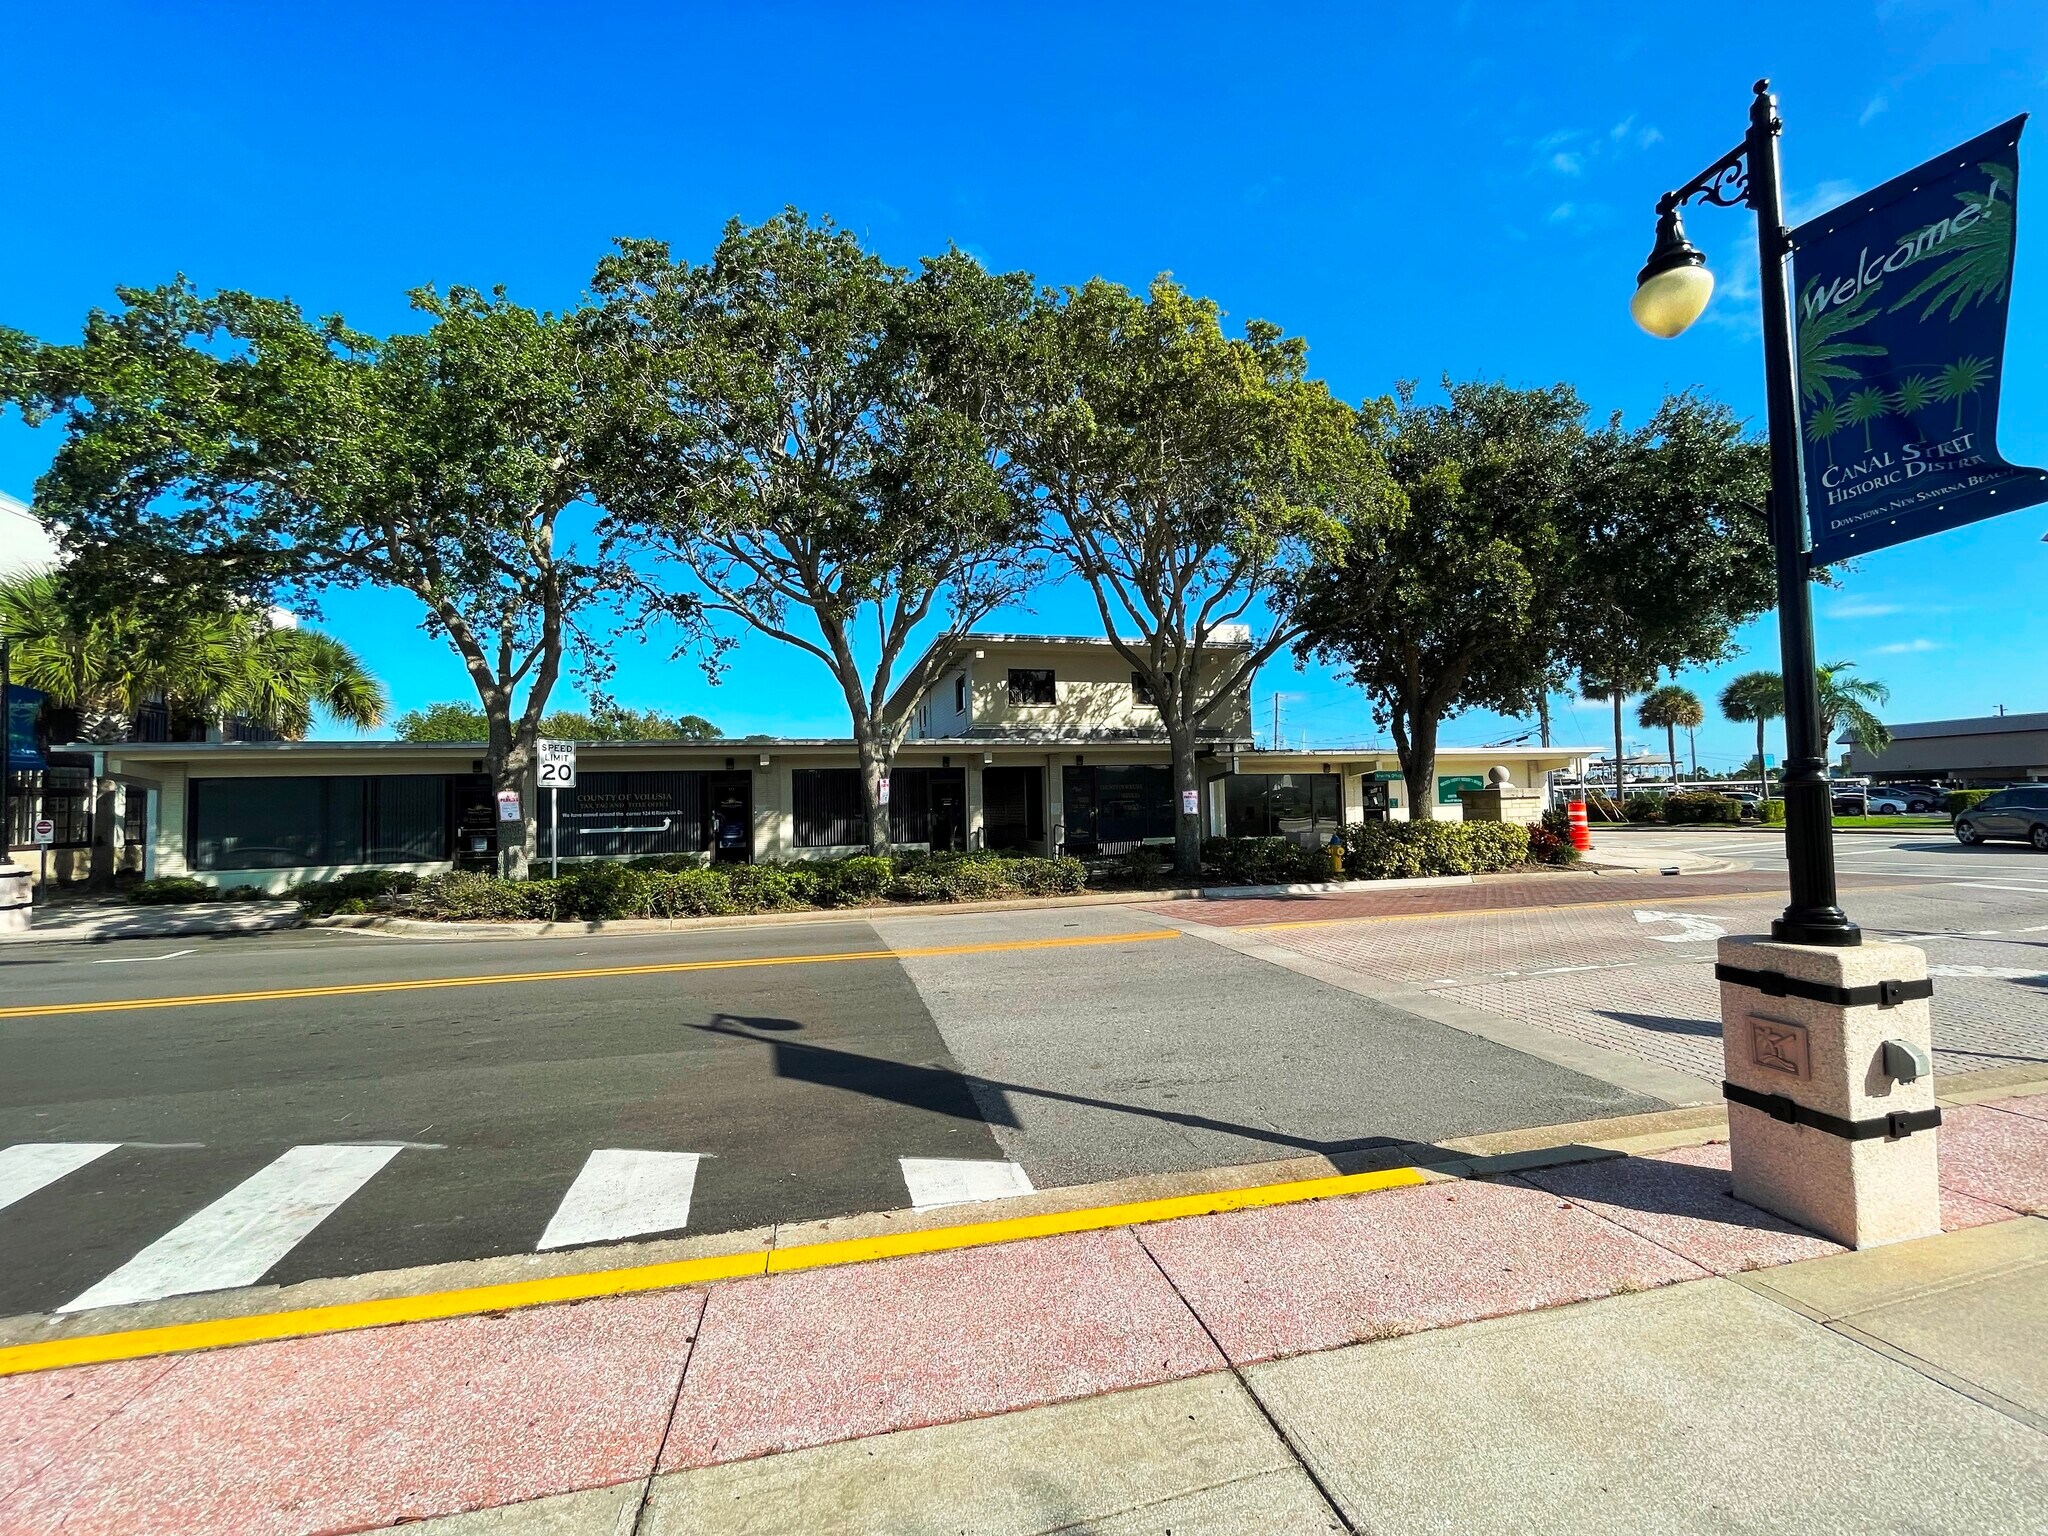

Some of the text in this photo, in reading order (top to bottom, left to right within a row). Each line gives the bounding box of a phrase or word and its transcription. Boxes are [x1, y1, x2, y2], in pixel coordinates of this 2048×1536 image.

[1804, 179, 1999, 320] Welcome!
[1822, 451, 1895, 488] CANAL
[1827, 470, 1902, 506] HISTORIC
[1830, 507, 1888, 530] DOWNTOWN
[1889, 496, 1915, 511] NEW
[1916, 482, 1966, 502] SMYRNA
[541, 743, 573, 753] SPEED
[544, 754, 569, 762] LIMIT
[542, 763, 572, 781] 20
[577, 794, 616, 802] COUNTY
[617, 793, 631, 801] OF
